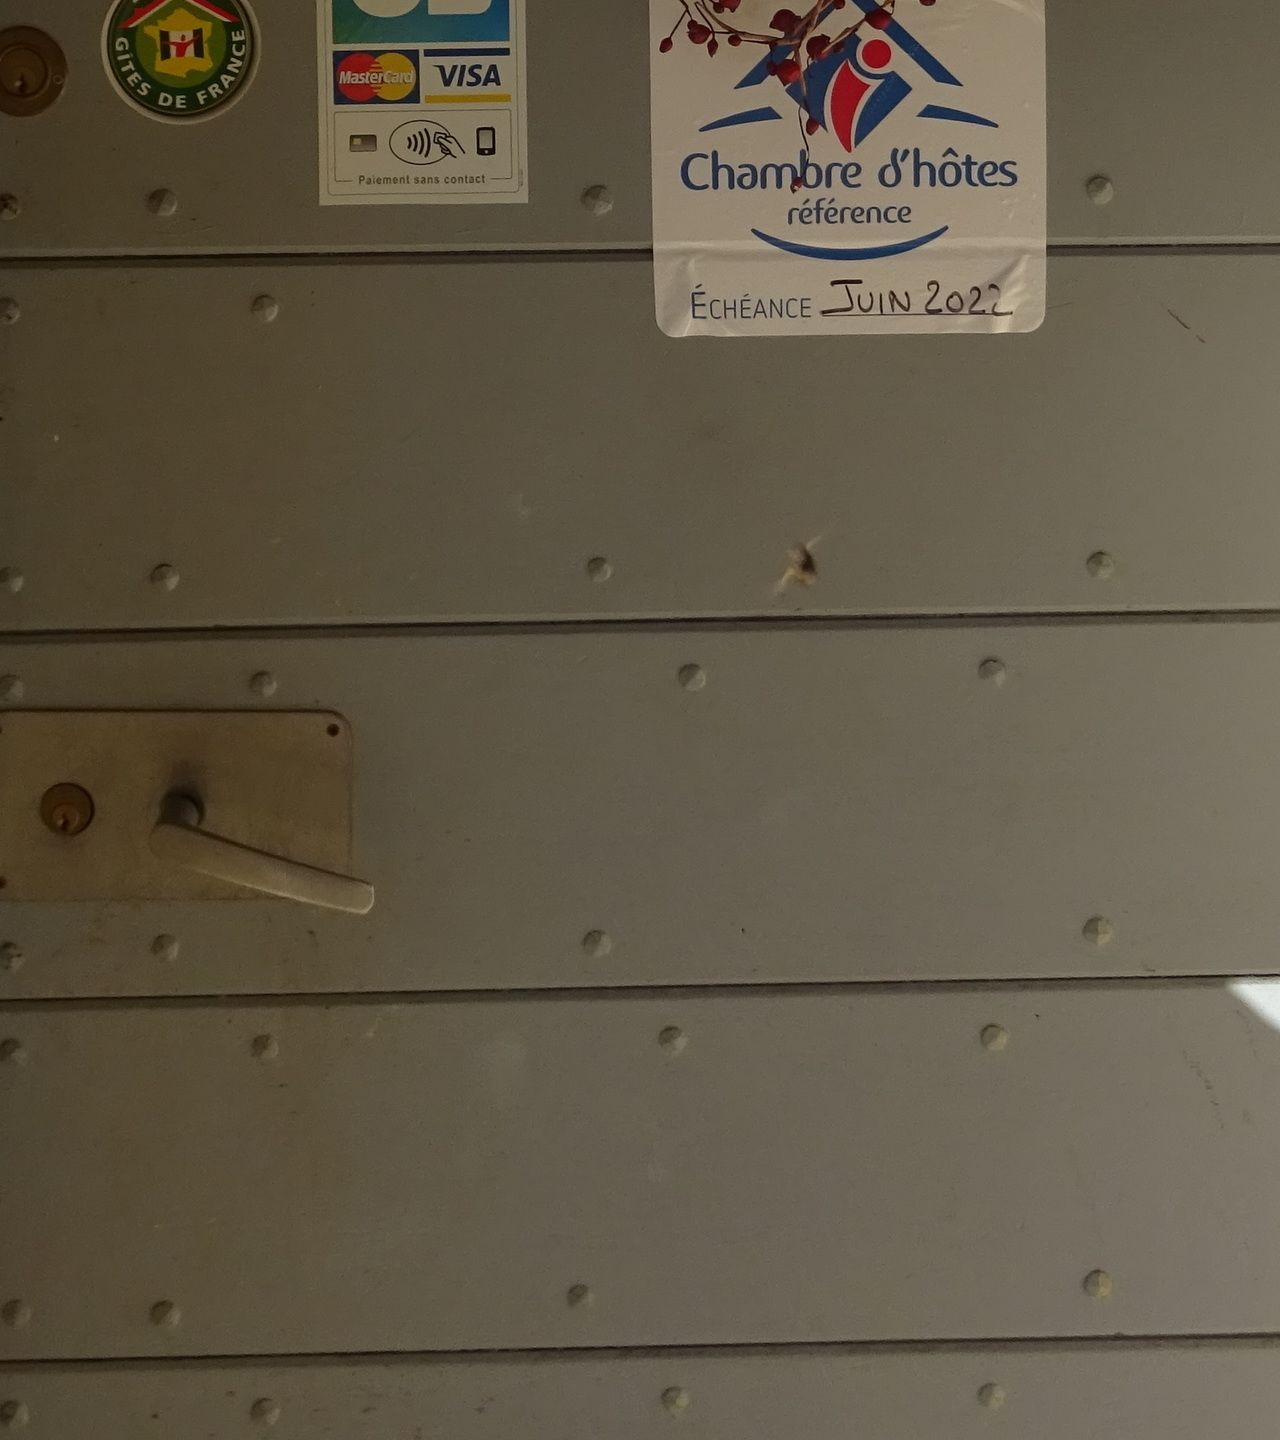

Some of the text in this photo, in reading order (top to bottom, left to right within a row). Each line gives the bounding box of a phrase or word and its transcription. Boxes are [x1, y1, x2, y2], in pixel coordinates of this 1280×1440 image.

[157, 91, 188, 109] DE
[196, 29, 246, 105] FRANCE
[339, 64, 502, 87] MasterCard VISA
[358, 174, 486, 185] Paiement sans contact
[680, 147, 1019, 191] Chambre d'hôtes
[787, 197, 913, 225] référence
[691, 284, 812, 320] ÉCHÉANCE
[821, 279, 912, 315] JUIN
